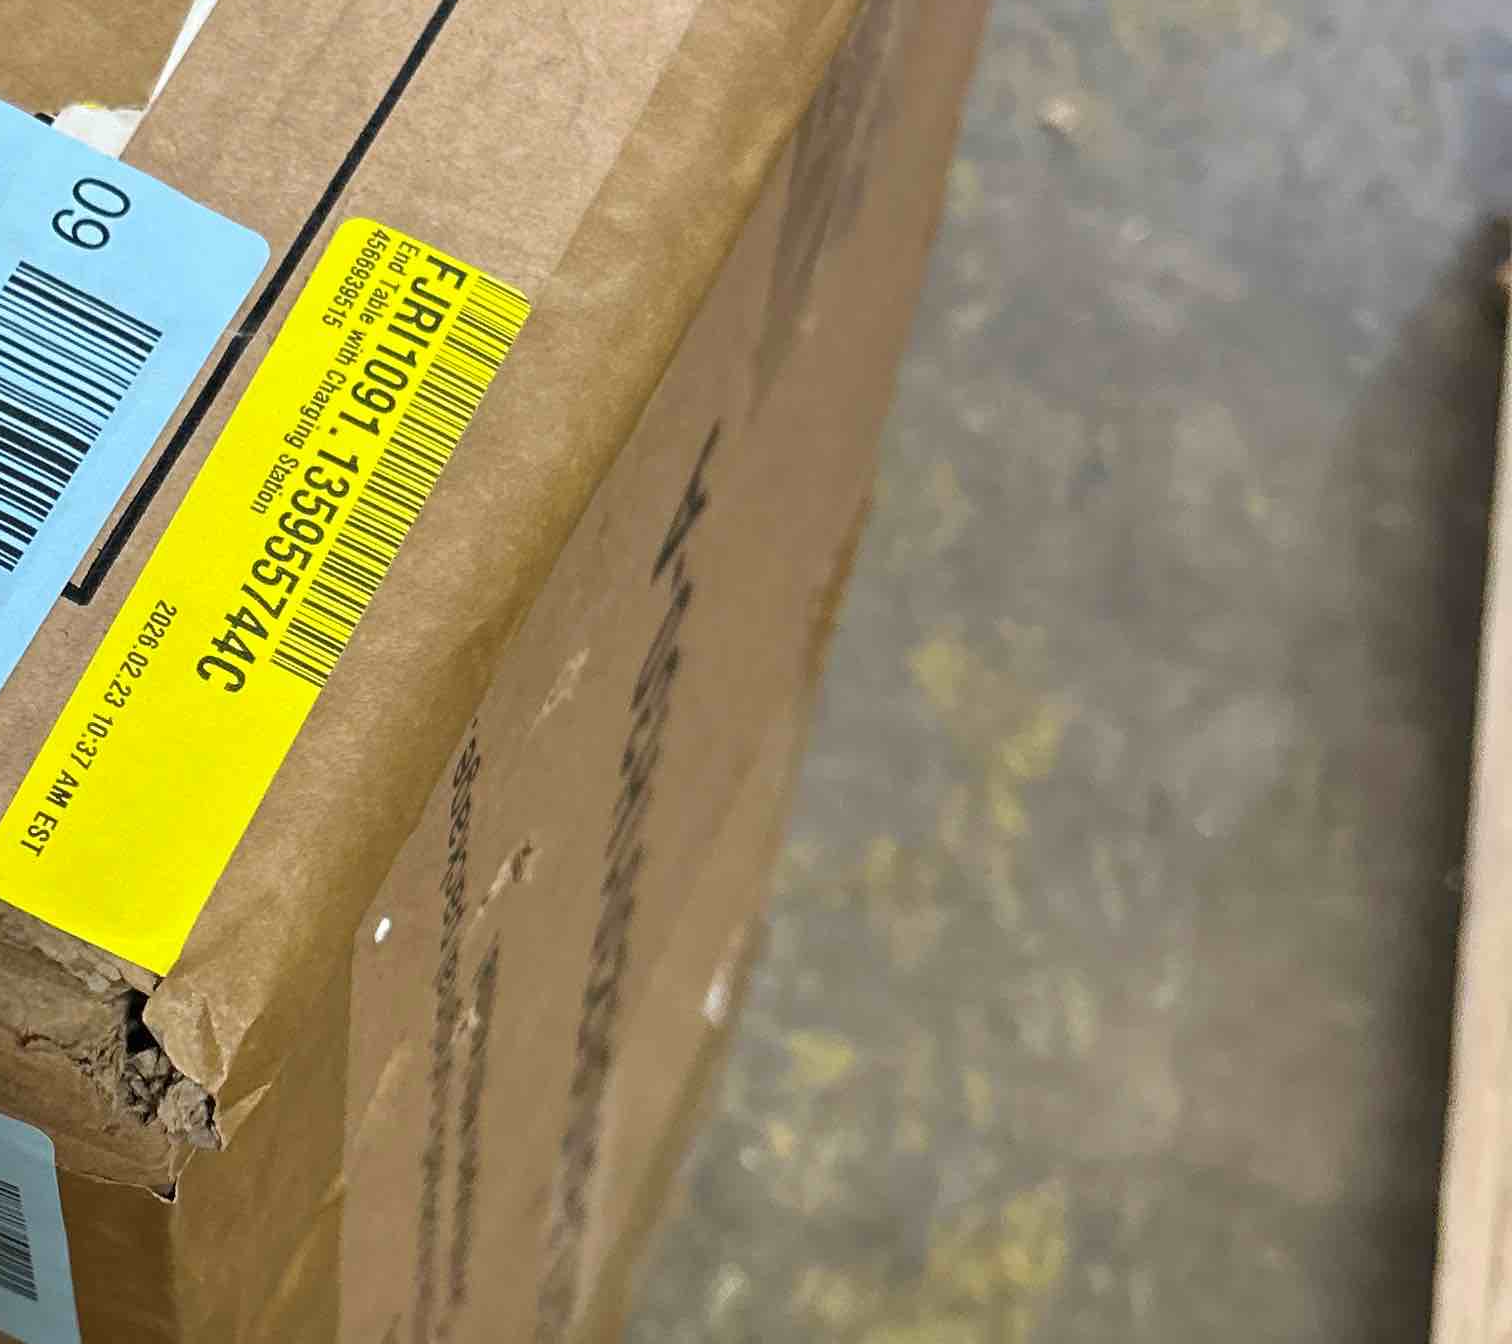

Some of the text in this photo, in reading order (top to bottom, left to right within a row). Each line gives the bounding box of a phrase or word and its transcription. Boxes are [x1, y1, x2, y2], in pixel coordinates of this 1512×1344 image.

[51, 176, 131, 250] 09
[322, 228, 391, 329] 4566939515
[250, 240, 421, 515] End Table with Charging Station
[20, 600, 178, 857] 2026.02.23 10:37 AM EST
